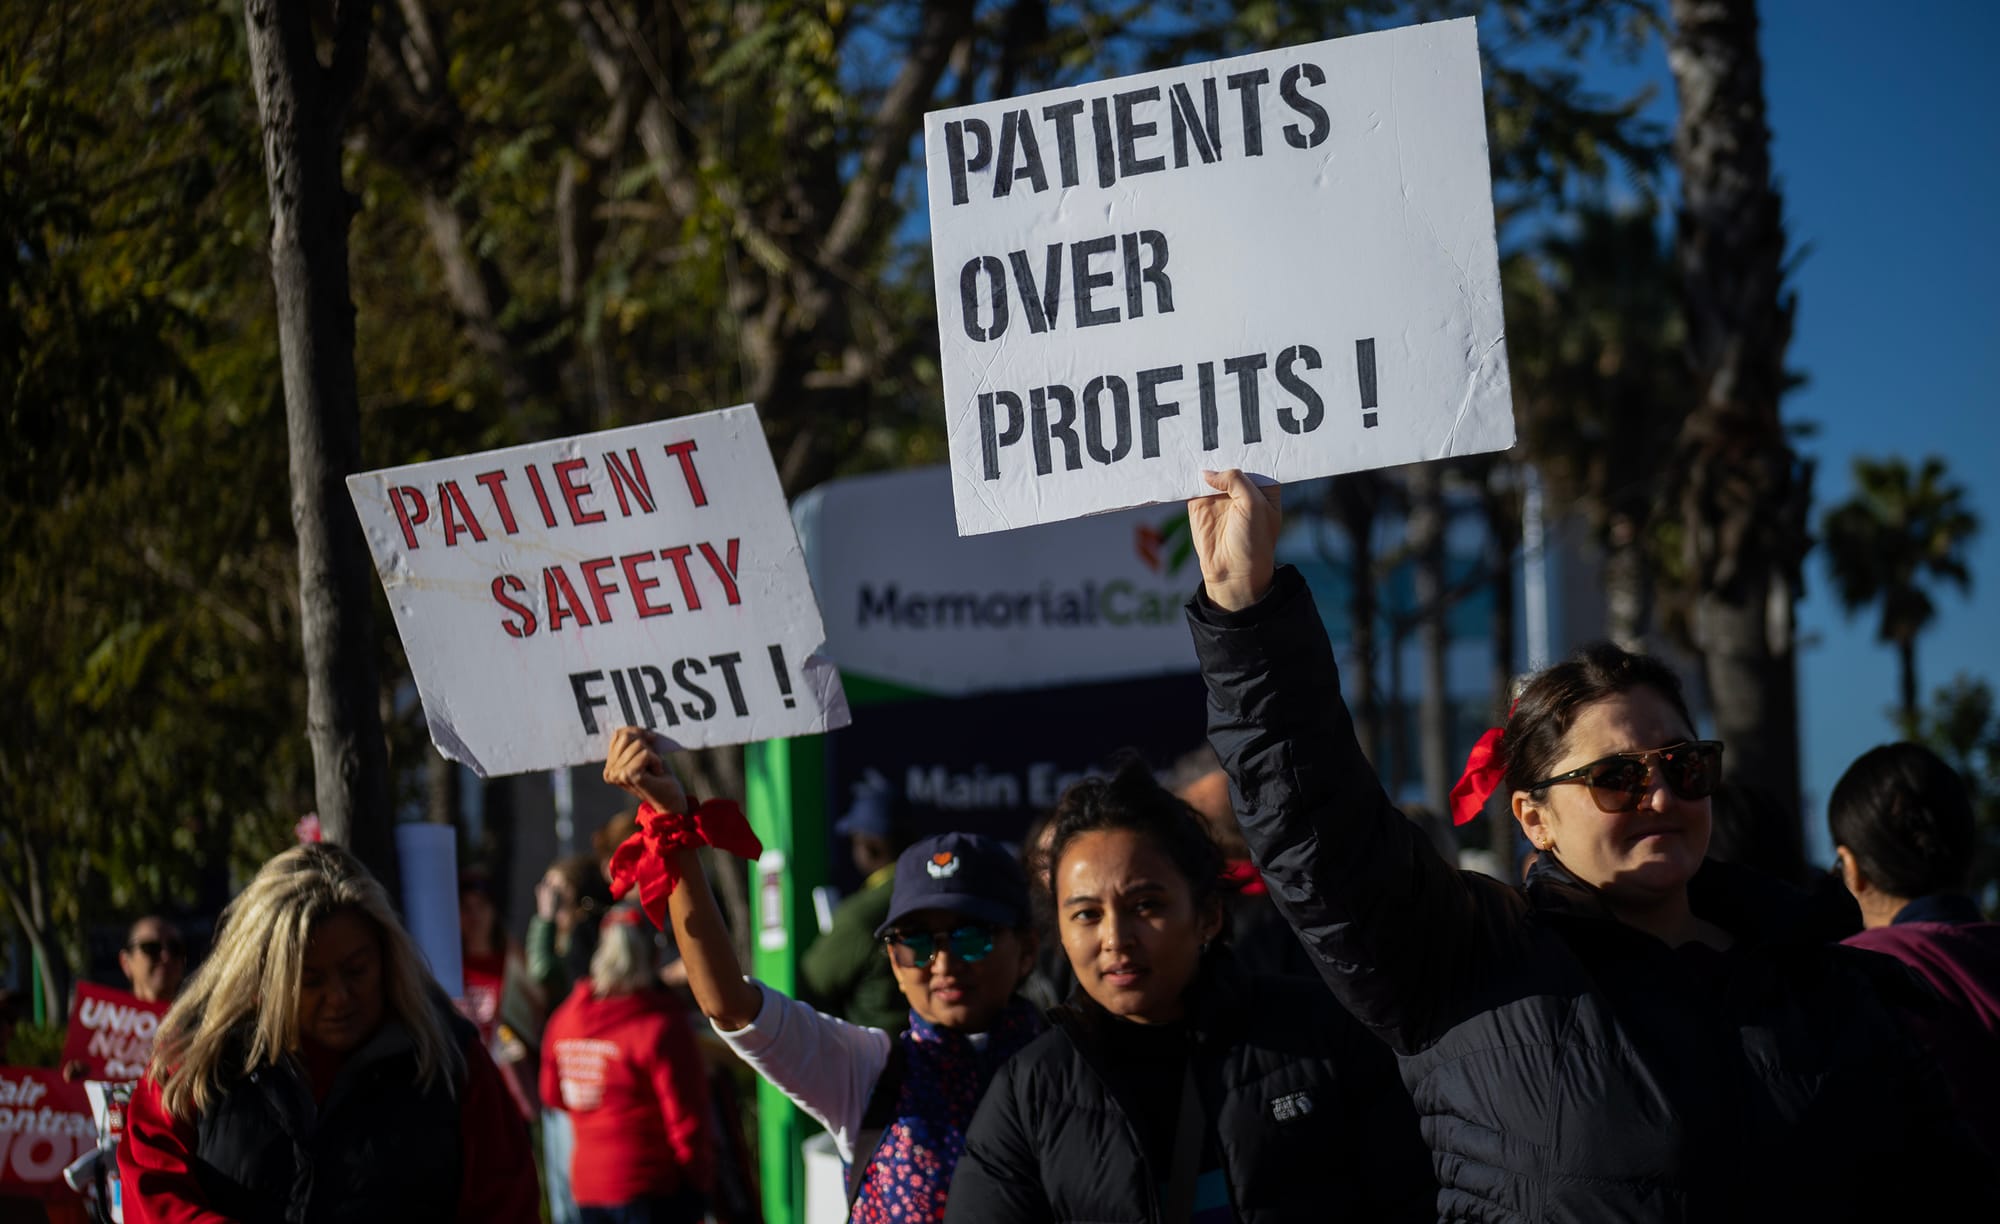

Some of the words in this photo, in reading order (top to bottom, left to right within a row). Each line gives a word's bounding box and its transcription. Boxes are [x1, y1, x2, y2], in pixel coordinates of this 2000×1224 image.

[945, 62, 1331, 206] PATIENTS
[960, 229, 1175, 343] OVER
[978, 344, 1325, 481] PROFITS
[387, 439, 708, 550] PATIENT
[491, 537, 741, 638] SAFETY
[856, 578, 1183, 628] MemorialCar
[569, 651, 749, 736] FIRST
[905, 765, 1019, 809] Main
[80, 997, 157, 1040] UNIO
[0, 1075, 45, 1107] air
